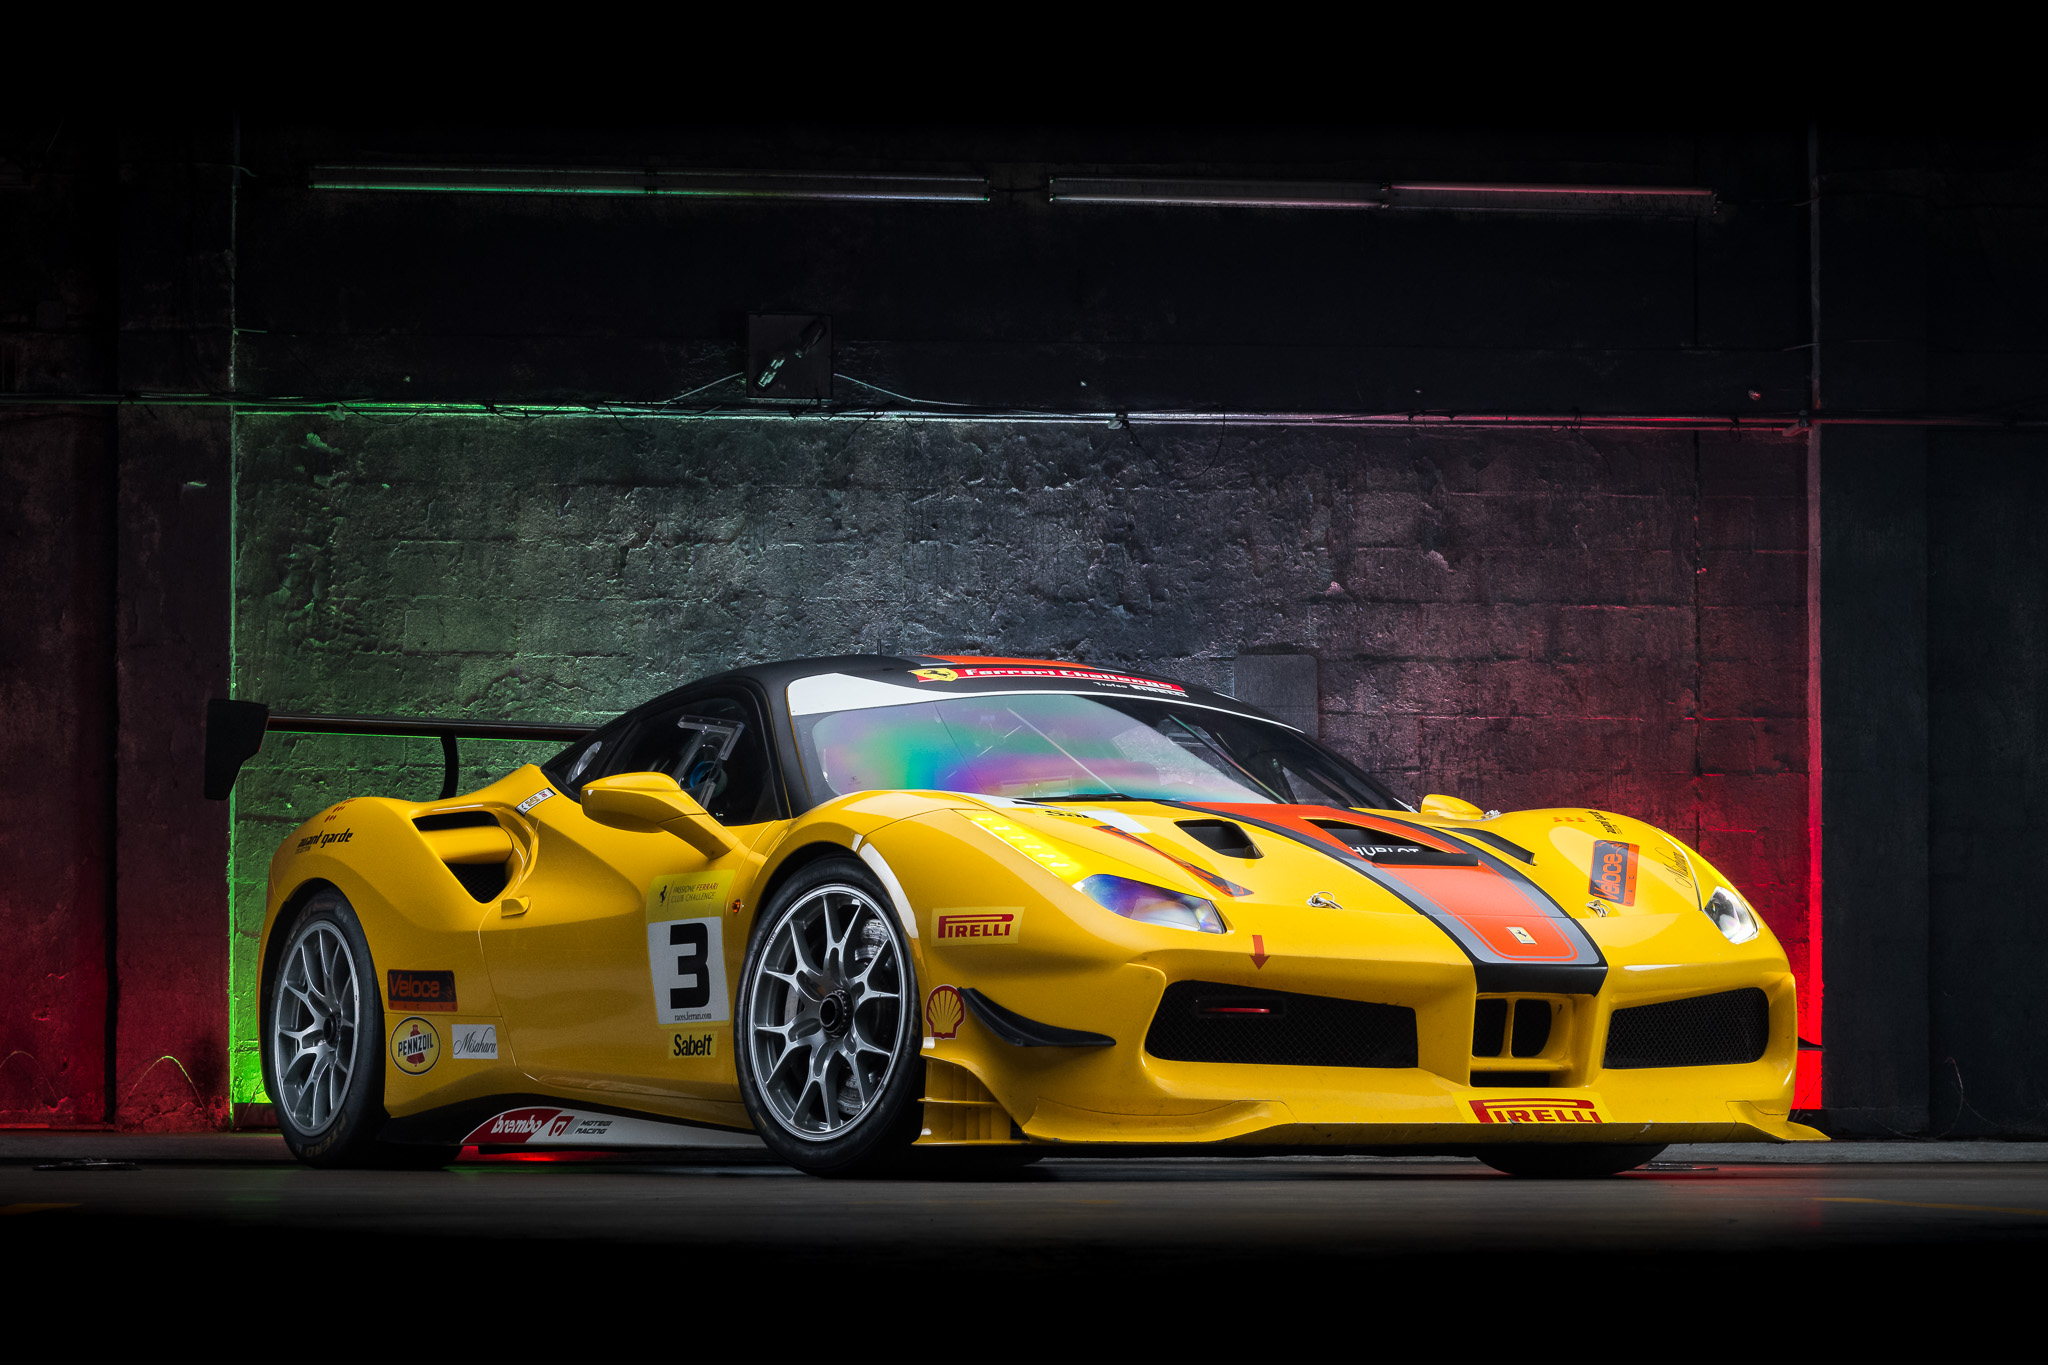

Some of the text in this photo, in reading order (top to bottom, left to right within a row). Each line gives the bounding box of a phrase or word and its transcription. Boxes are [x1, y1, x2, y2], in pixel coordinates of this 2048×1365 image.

[965, 668, 1173, 689] Ferrari Challenge
[320, 828, 353, 848] garde
[696, 882, 719, 892] FERRARI
[1593, 853, 1623, 900] Veloce
[671, 892, 716, 903] CLUB CHALLENGE
[938, 914, 1014, 939] PIRELLI
[669, 922, 711, 1010] 3
[388, 973, 441, 998] Veloce
[397, 1033, 434, 1058] PENNZOIL
[673, 1033, 713, 1057] Sabelt
[1468, 1098, 1603, 1124] PIRELLI
[490, 1114, 543, 1134] brembo
